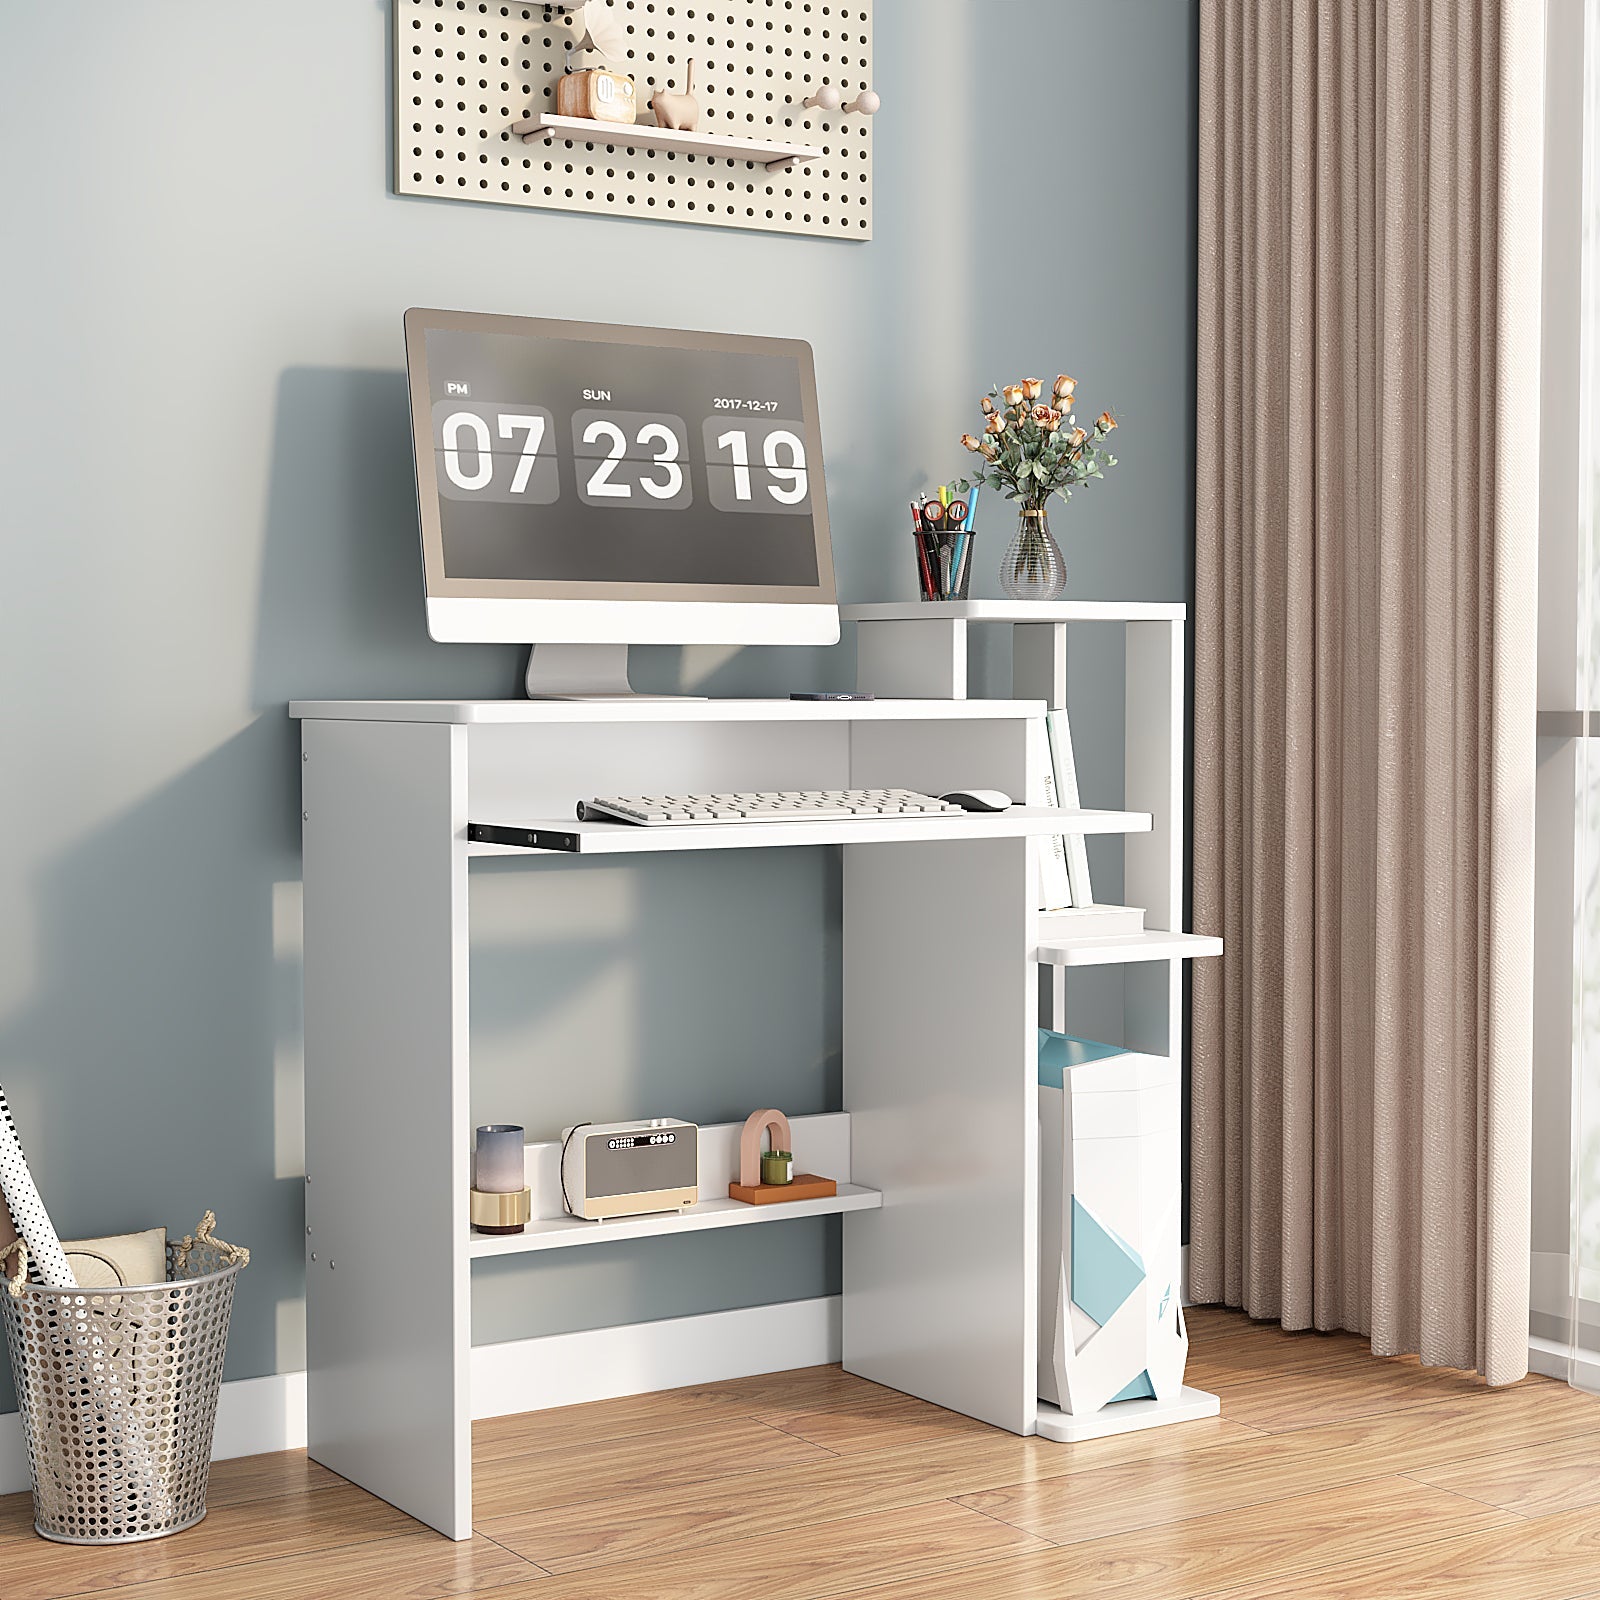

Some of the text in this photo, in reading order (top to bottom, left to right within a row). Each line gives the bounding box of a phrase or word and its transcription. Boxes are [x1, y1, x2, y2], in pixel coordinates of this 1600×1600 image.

[447, 383, 468, 395] PM
[583, 389, 611, 401] SUN
[713, 398, 778, 412] 2017-12-17
[442, 412, 808, 505] 07 23 19
